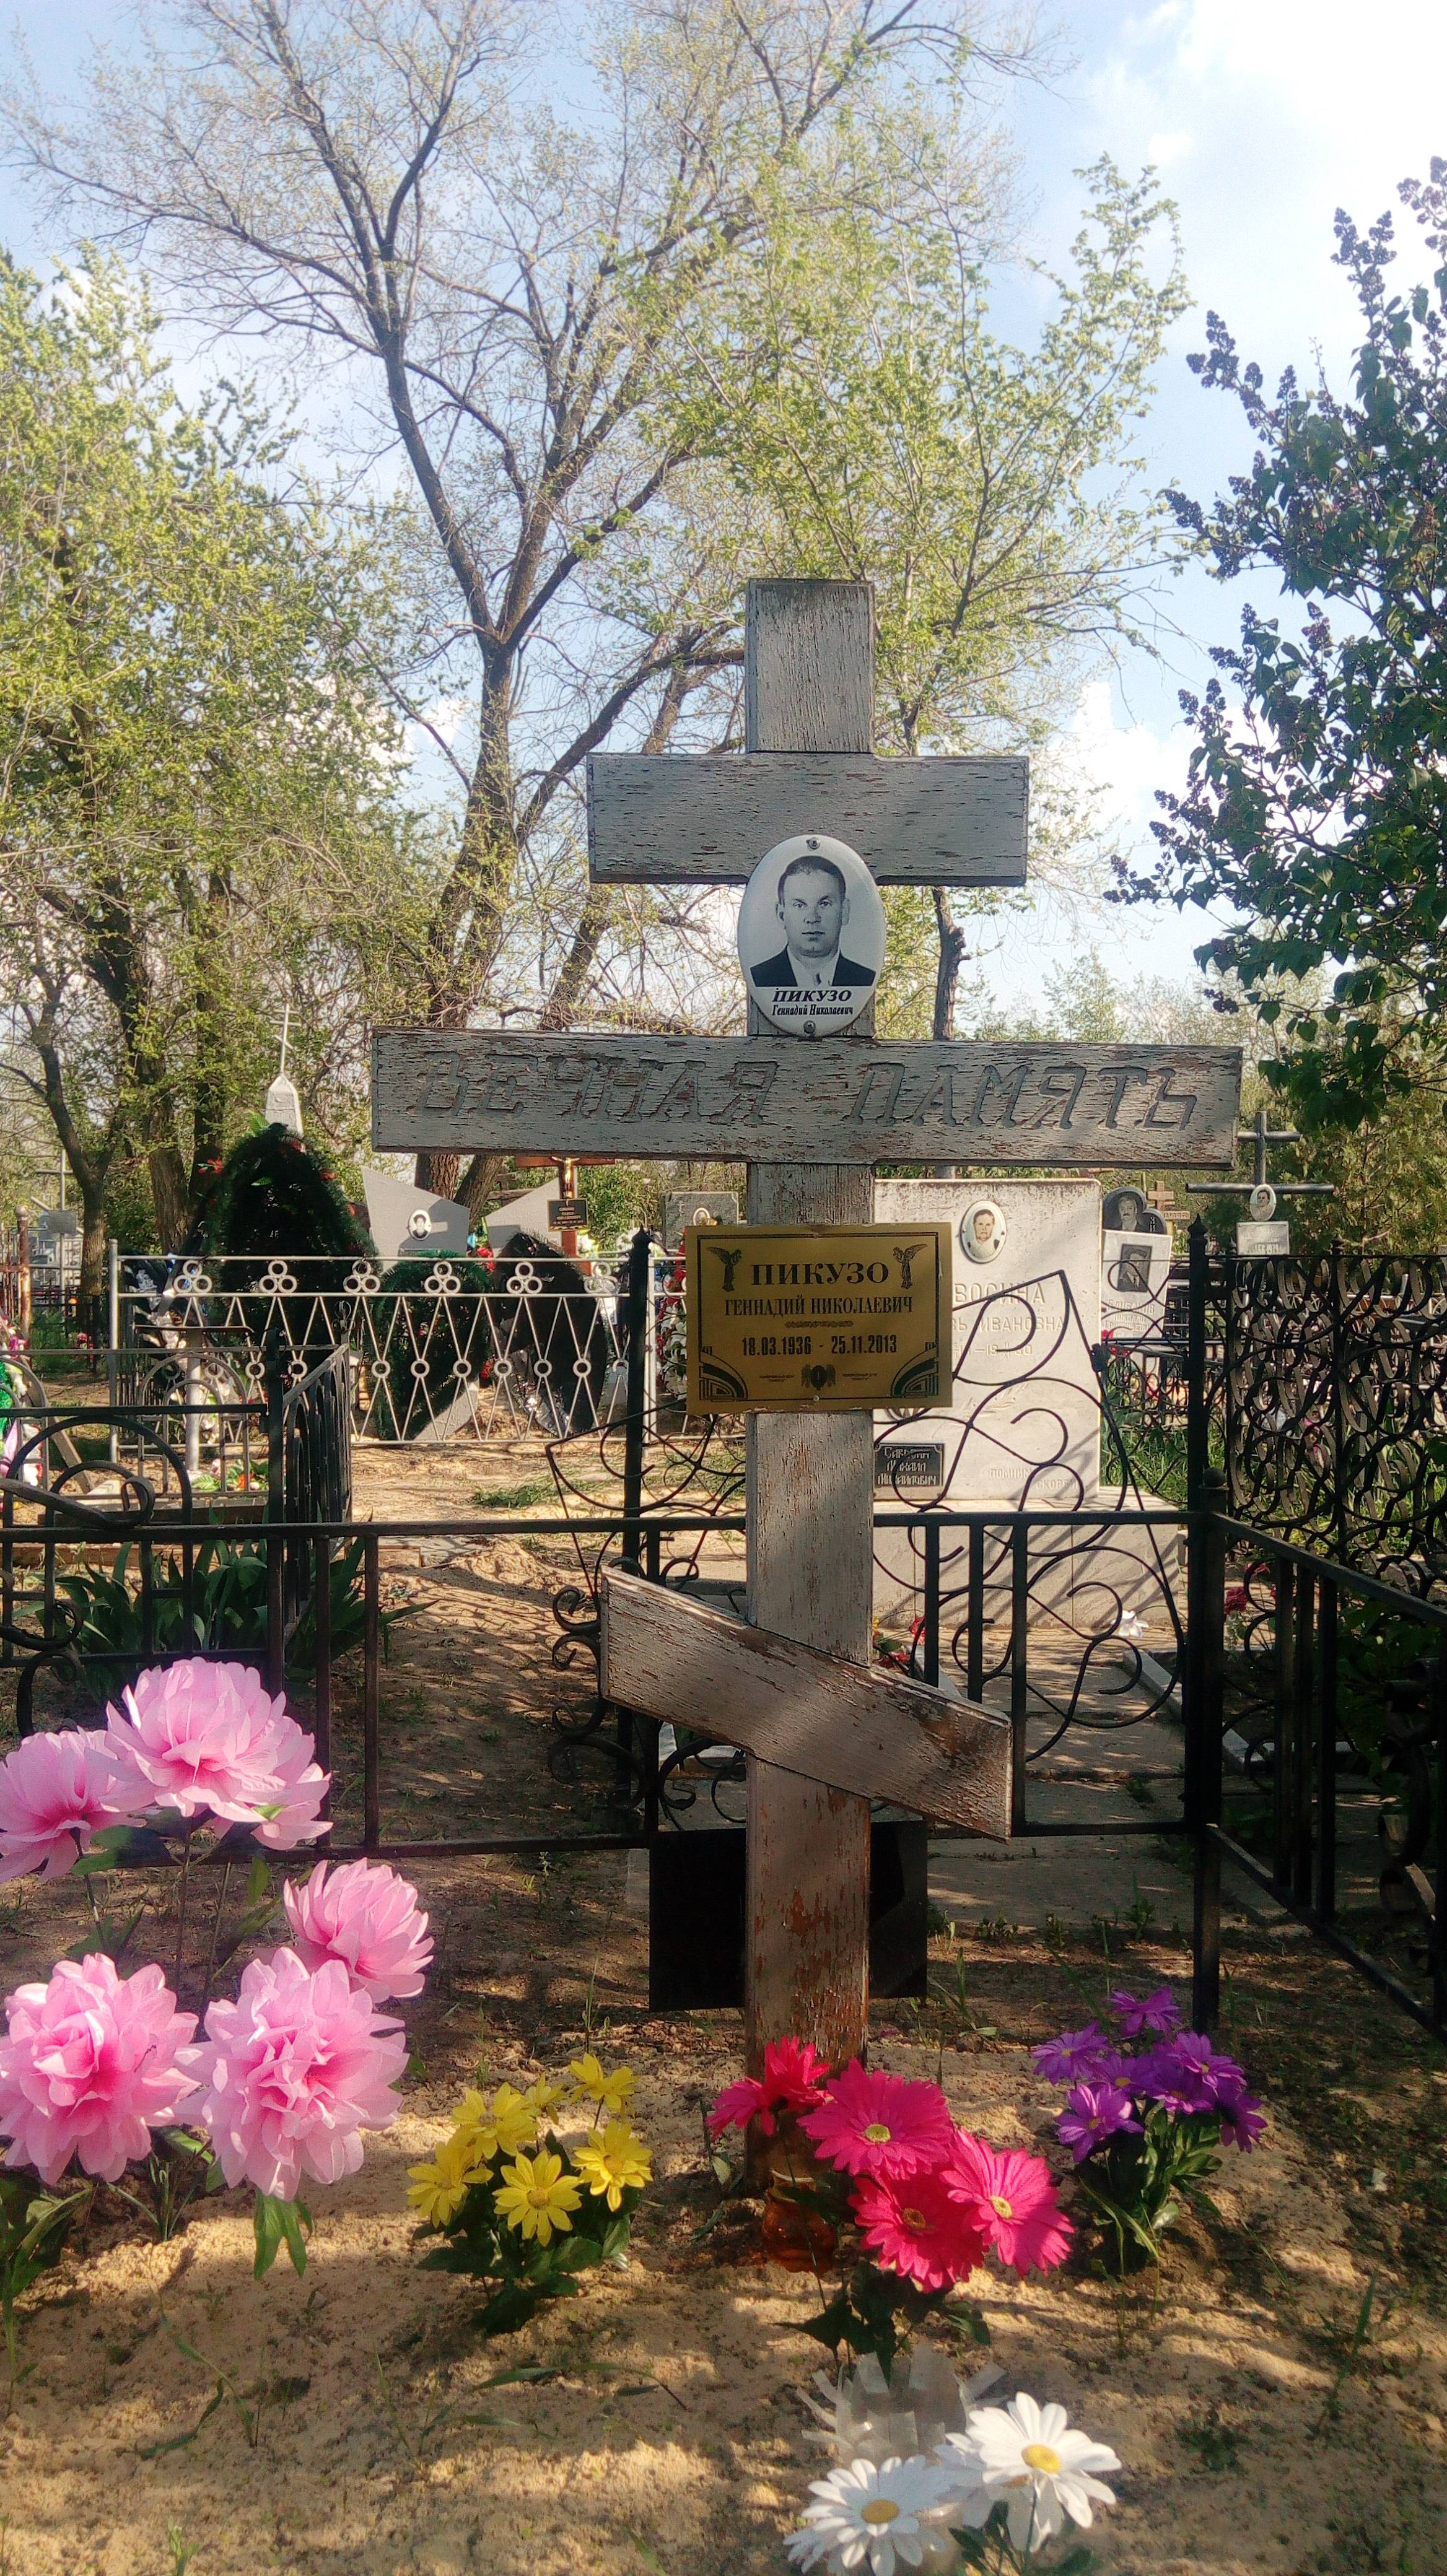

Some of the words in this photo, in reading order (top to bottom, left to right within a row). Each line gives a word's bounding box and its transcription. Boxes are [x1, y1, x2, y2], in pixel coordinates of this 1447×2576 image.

[772, 990, 852, 1003] ПИКУЗО
[772, 1004, 808, 1016] Геннадий
[809, 1004, 854, 1016] Николаевич
[406, 1051, 777, 1125] ВЕЧНАЯ
[841, 1061, 1197, 1131] ПАМЯТЬ
[751, 1262, 889, 1286] ПИКУЗО
[724, 1295, 805, 1317] ГЕННАДИЙ
[811, 1296, 913, 1314] НИКОЛАЕВИЧ
[742, 1336, 811, 1355] 18.03.1936
[831, 1334, 898, 1354] 25.11.2013
